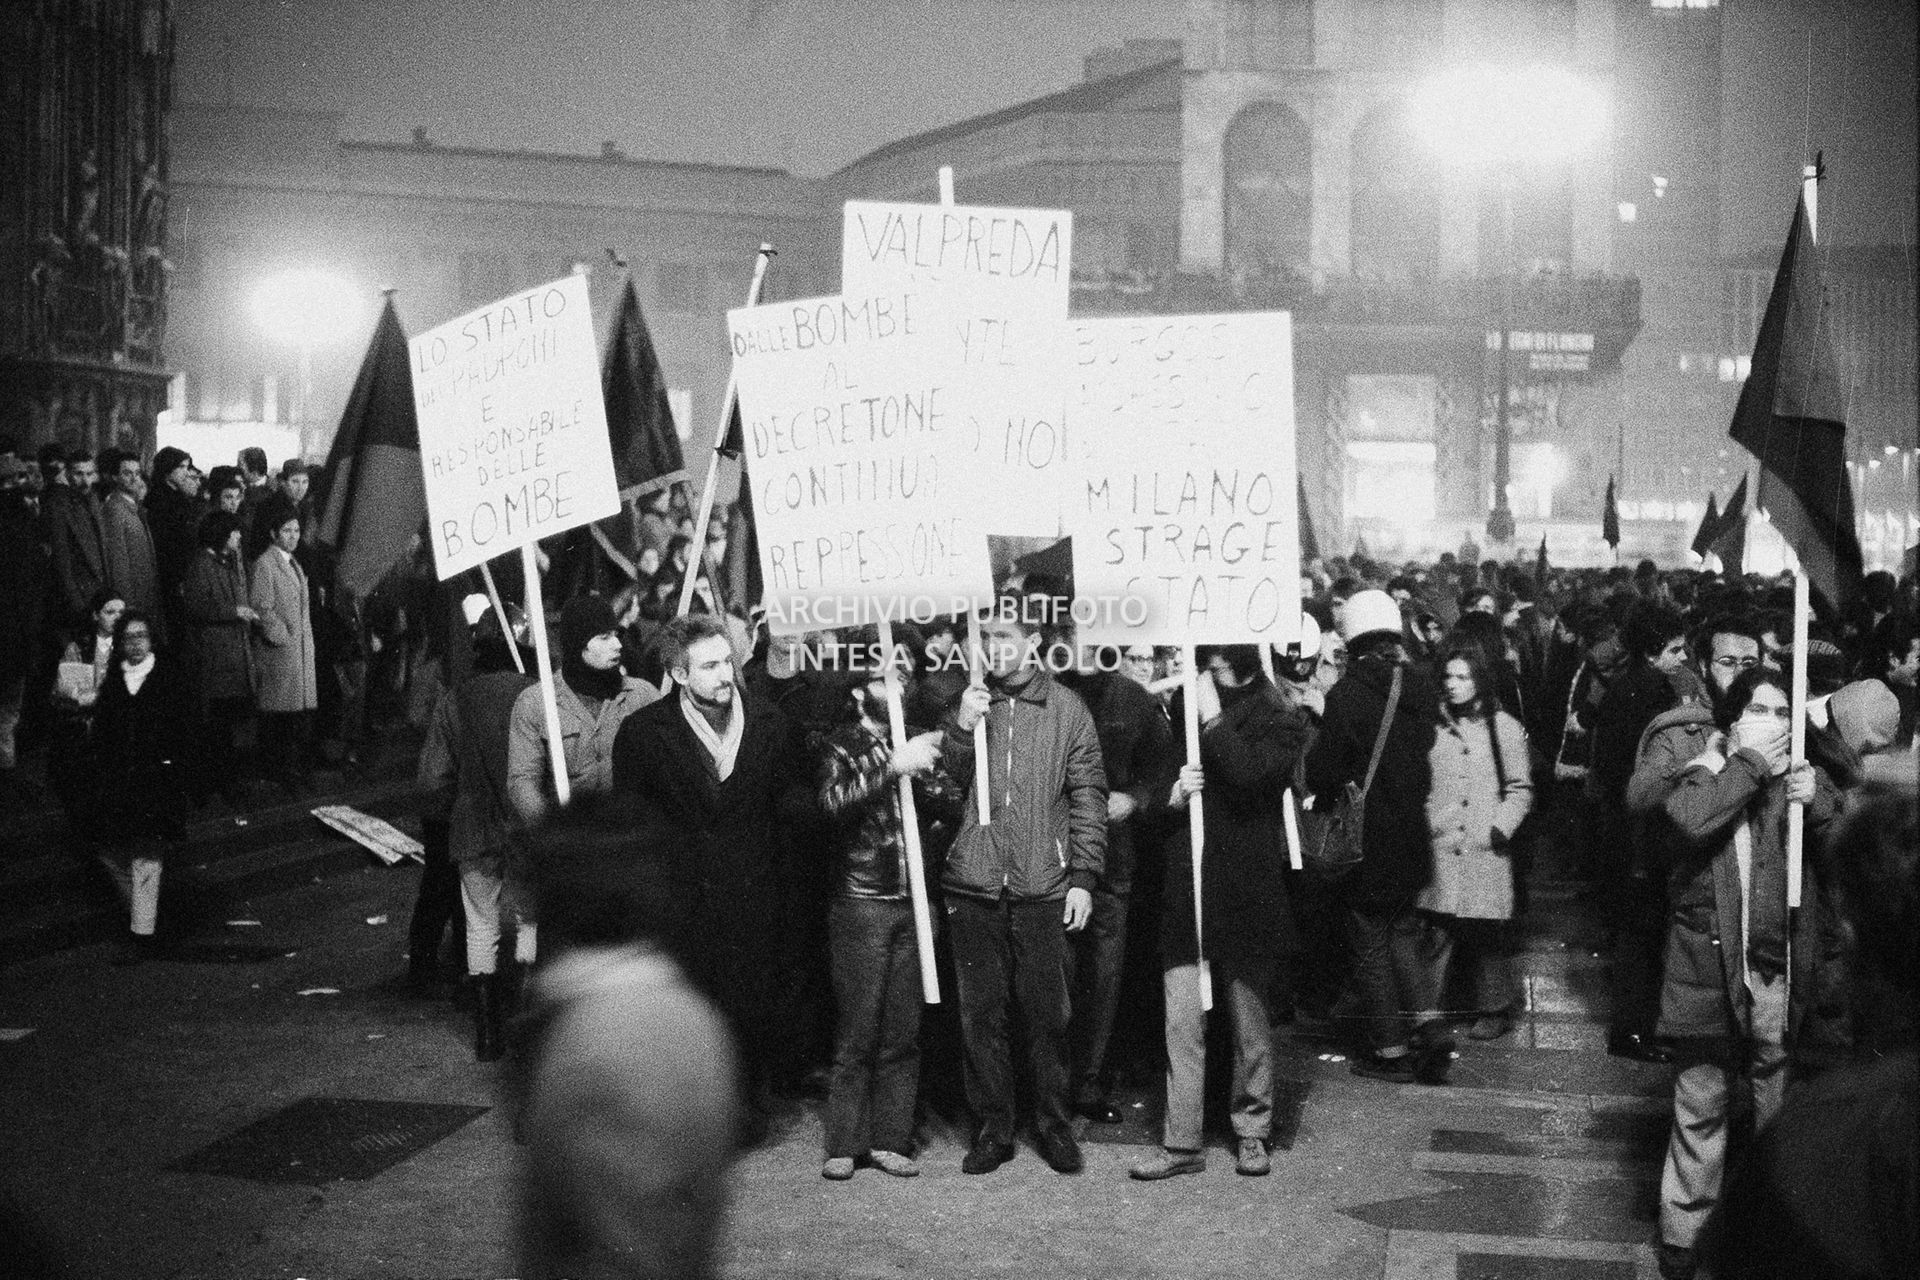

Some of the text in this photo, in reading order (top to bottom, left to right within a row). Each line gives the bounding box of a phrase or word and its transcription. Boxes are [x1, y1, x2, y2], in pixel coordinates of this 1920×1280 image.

[858, 211, 1060, 283] VALPREDA
[418, 288, 567, 374] LO STATO
[733, 293, 917, 358] DALLE BOMBE
[823, 361, 859, 391] AL
[431, 399, 583, 479] RESPONSABILE
[752, 387, 945, 459] DECRETONE
[477, 441, 547, 487] DELLE
[1086, 468, 1274, 517] MILANO
[441, 470, 573, 559] BOMBE
[1105, 520, 1283, 566] STRAGE
[1125, 574, 1281, 634] STATO
